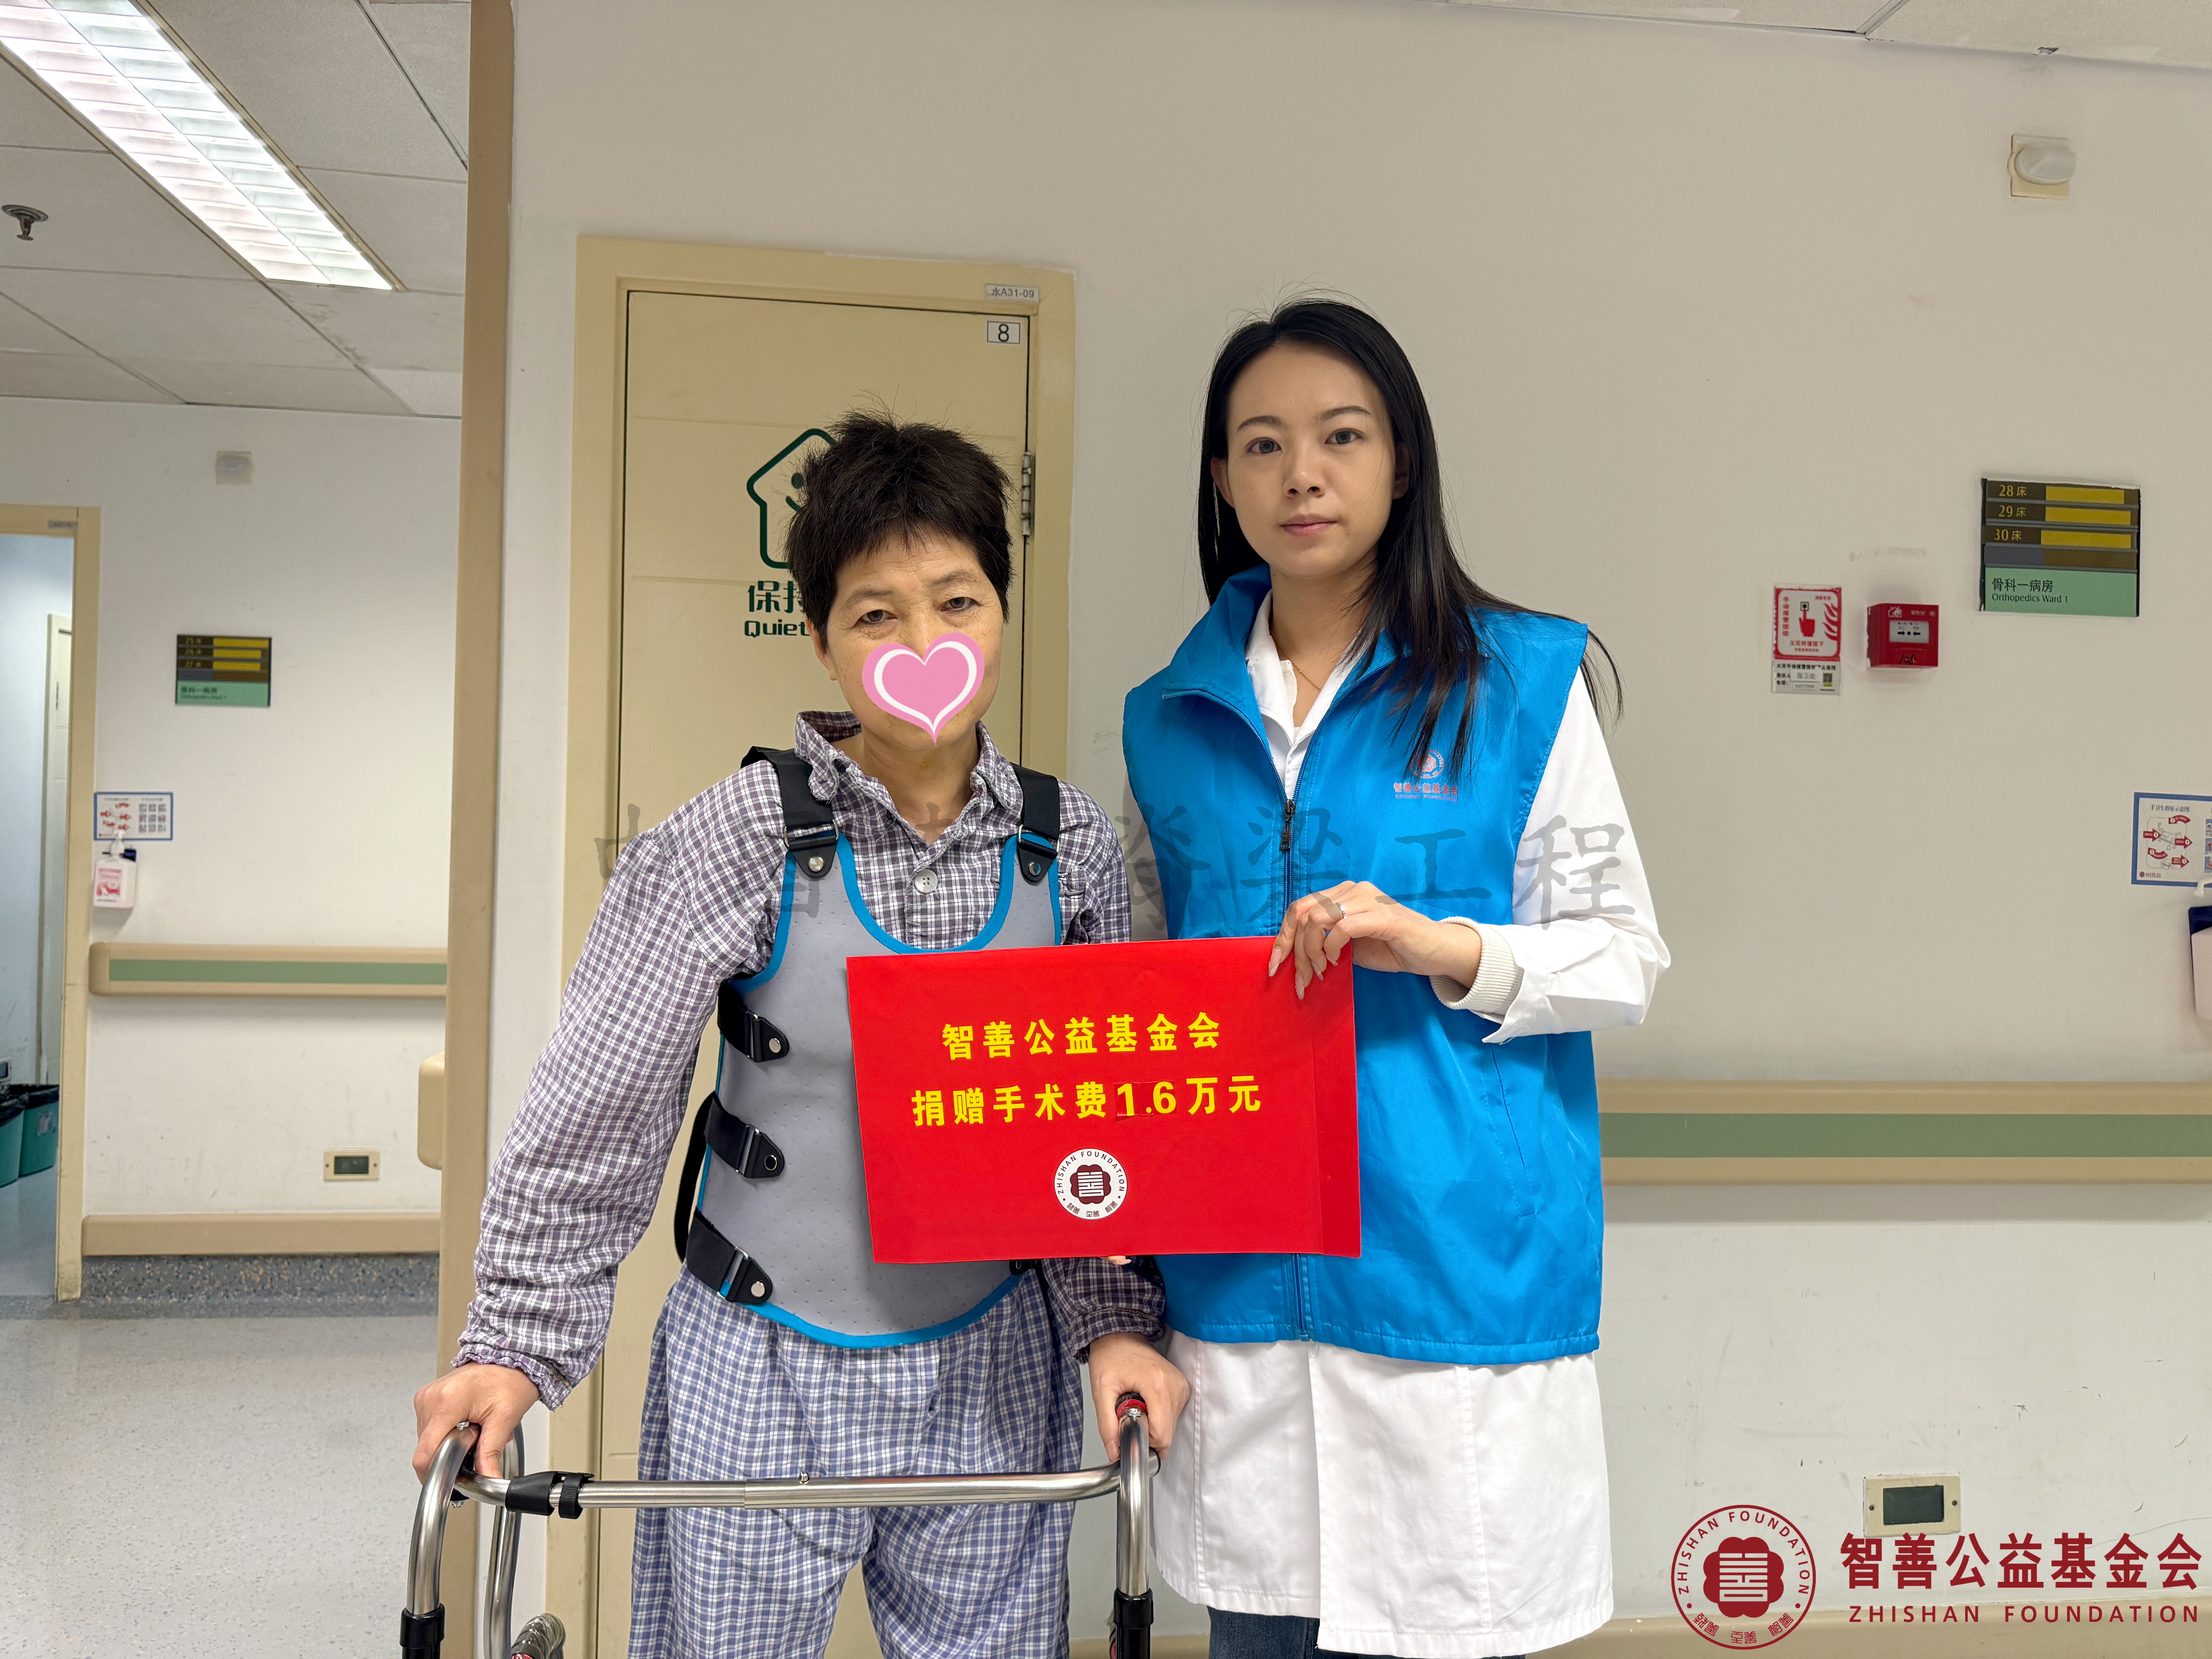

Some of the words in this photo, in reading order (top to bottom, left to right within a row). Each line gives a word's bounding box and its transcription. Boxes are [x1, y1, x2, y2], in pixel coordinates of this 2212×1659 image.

[998, 324, 1009, 343] 8
[1999, 485, 2013, 497] 28
[2016, 486, 2027, 497] 床
[1999, 505, 2013, 517] 29
[2016, 507, 2026, 518] 床
[1994, 529, 2009, 541] 30
[2011, 530, 2022, 541] 床
[1992, 578, 2054, 592] 骨科一病房
[1992, 593, 2040, 603] Orthopedics
[2042, 594, 2062, 603] Ward
[744, 619, 810, 638] Quiet
[943, 1012, 1220, 1061] 智善公益基金会
[911, 1075, 1261, 1127] 捐赠手术费1.6万元
[1057, 1155, 1076, 1194] ZHISHAN
[1081, 1151, 1125, 1192] FOUNDATION
